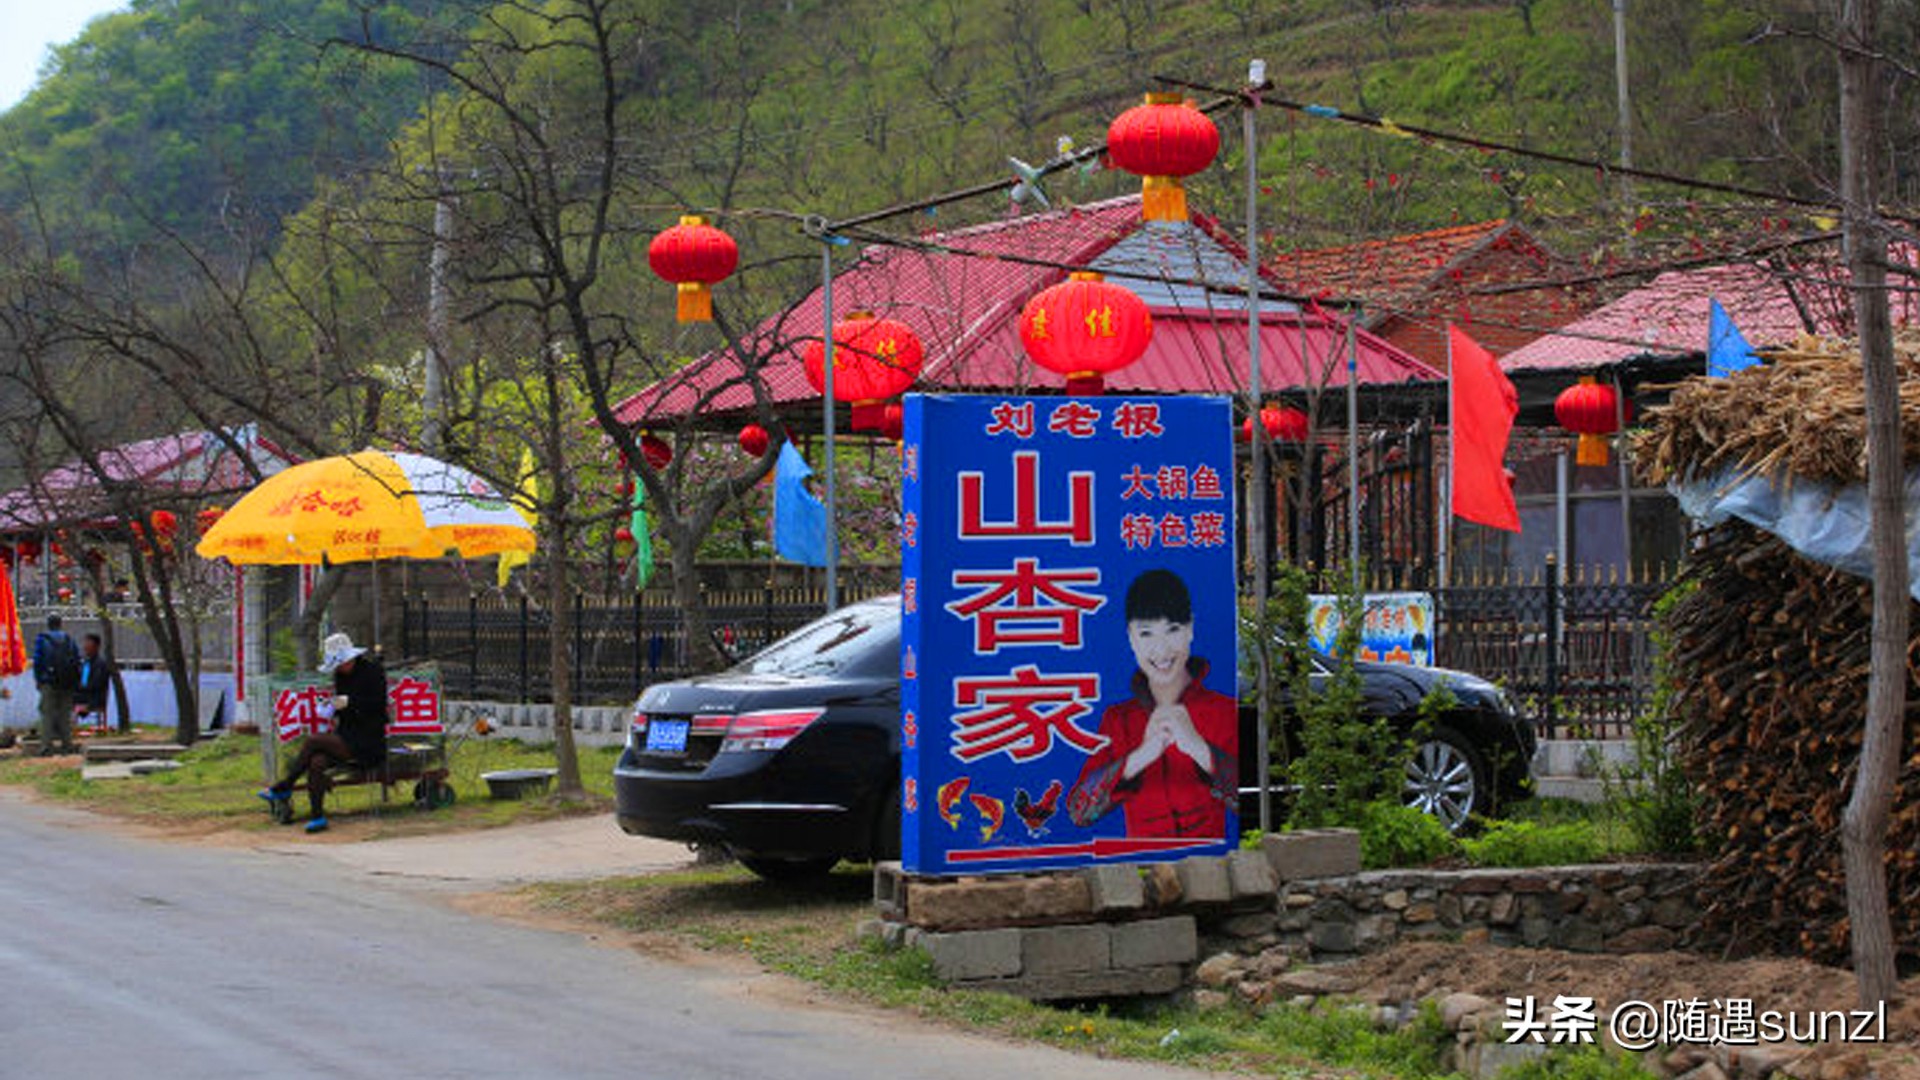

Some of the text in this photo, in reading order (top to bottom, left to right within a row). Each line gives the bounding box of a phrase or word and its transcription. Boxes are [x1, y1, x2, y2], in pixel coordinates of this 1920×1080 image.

[986, 402, 1164, 438] 刘老根
[1121, 465, 1223, 500] 大锅鱼
[1121, 512, 1226, 549] 特色菜
[945, 451, 1110, 763] 山杏家
